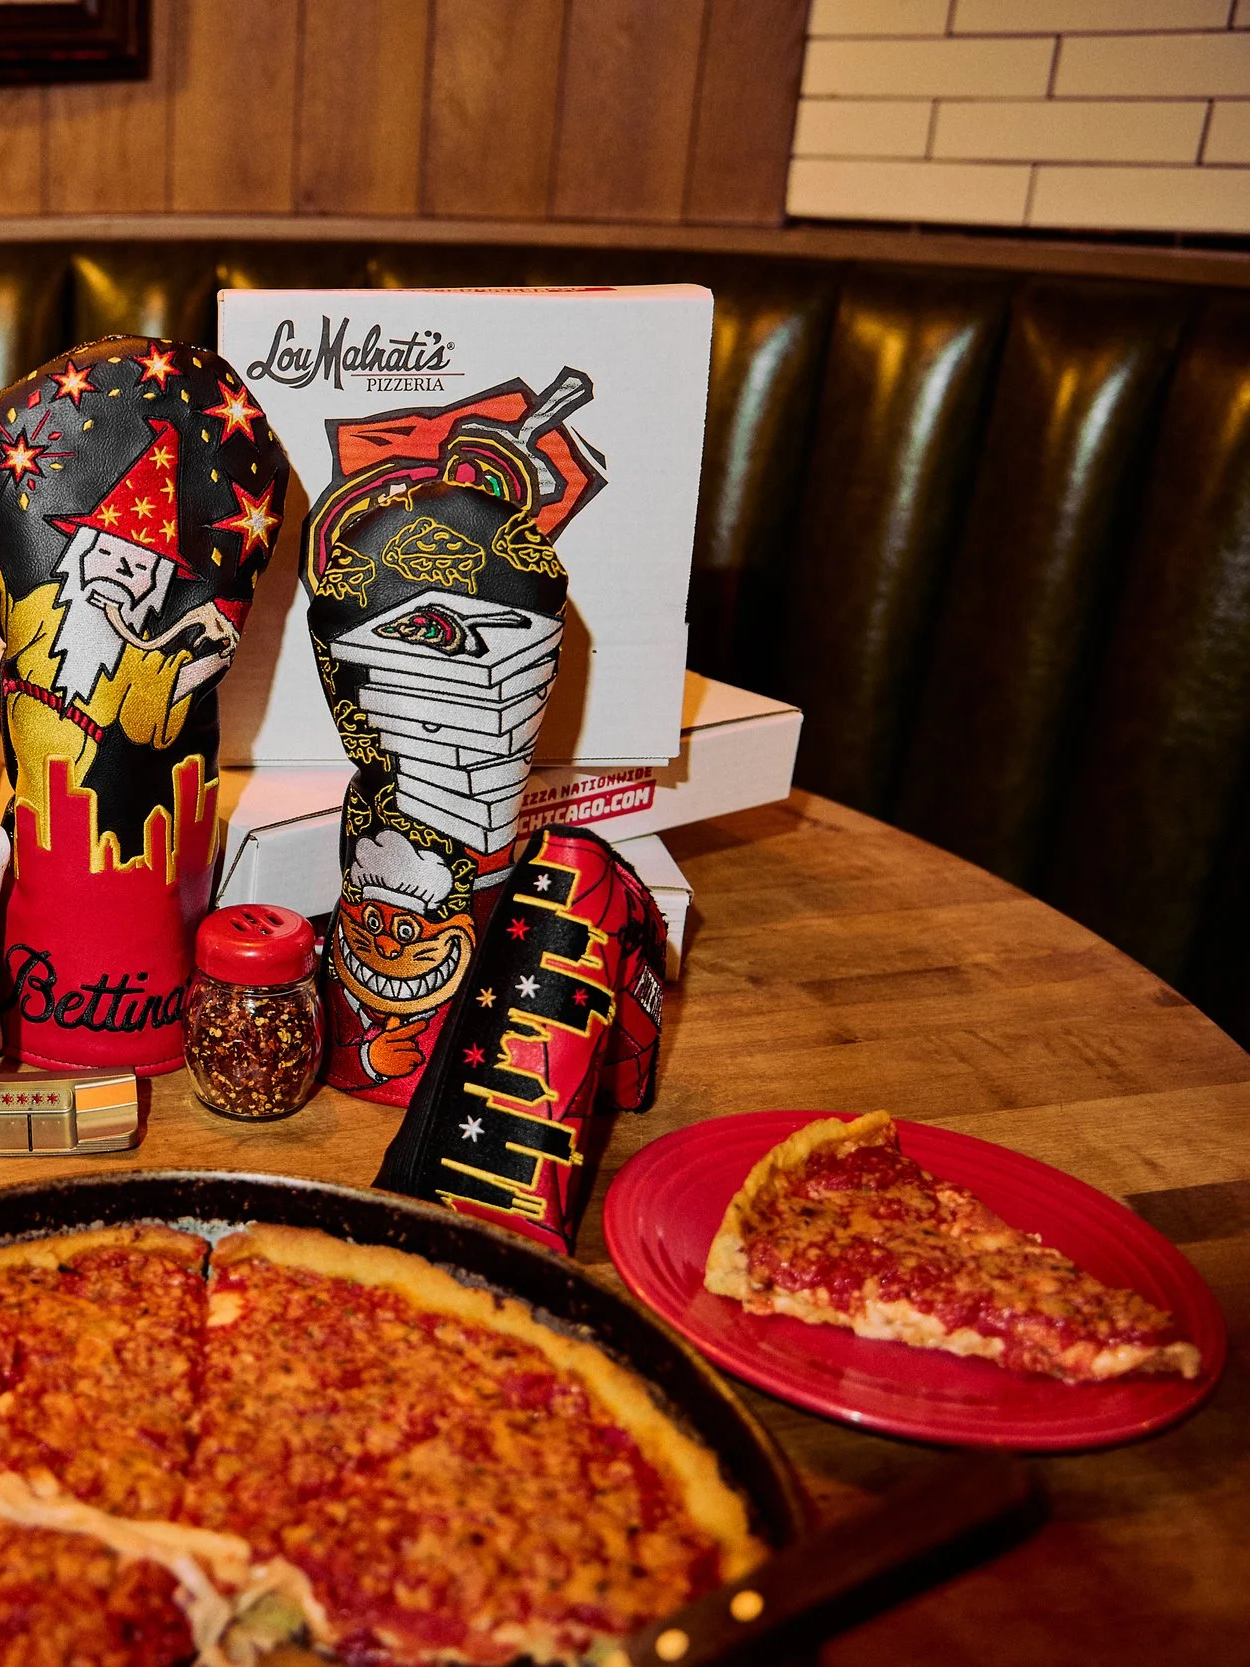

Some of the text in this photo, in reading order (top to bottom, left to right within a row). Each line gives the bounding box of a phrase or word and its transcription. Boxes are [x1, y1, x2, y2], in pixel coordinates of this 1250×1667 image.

[246, 314, 451, 391] Lou Malnati's
[366, 377, 445, 392] PIZZERIA
[521, 766, 652, 808] IZZA NATIONWIDE
